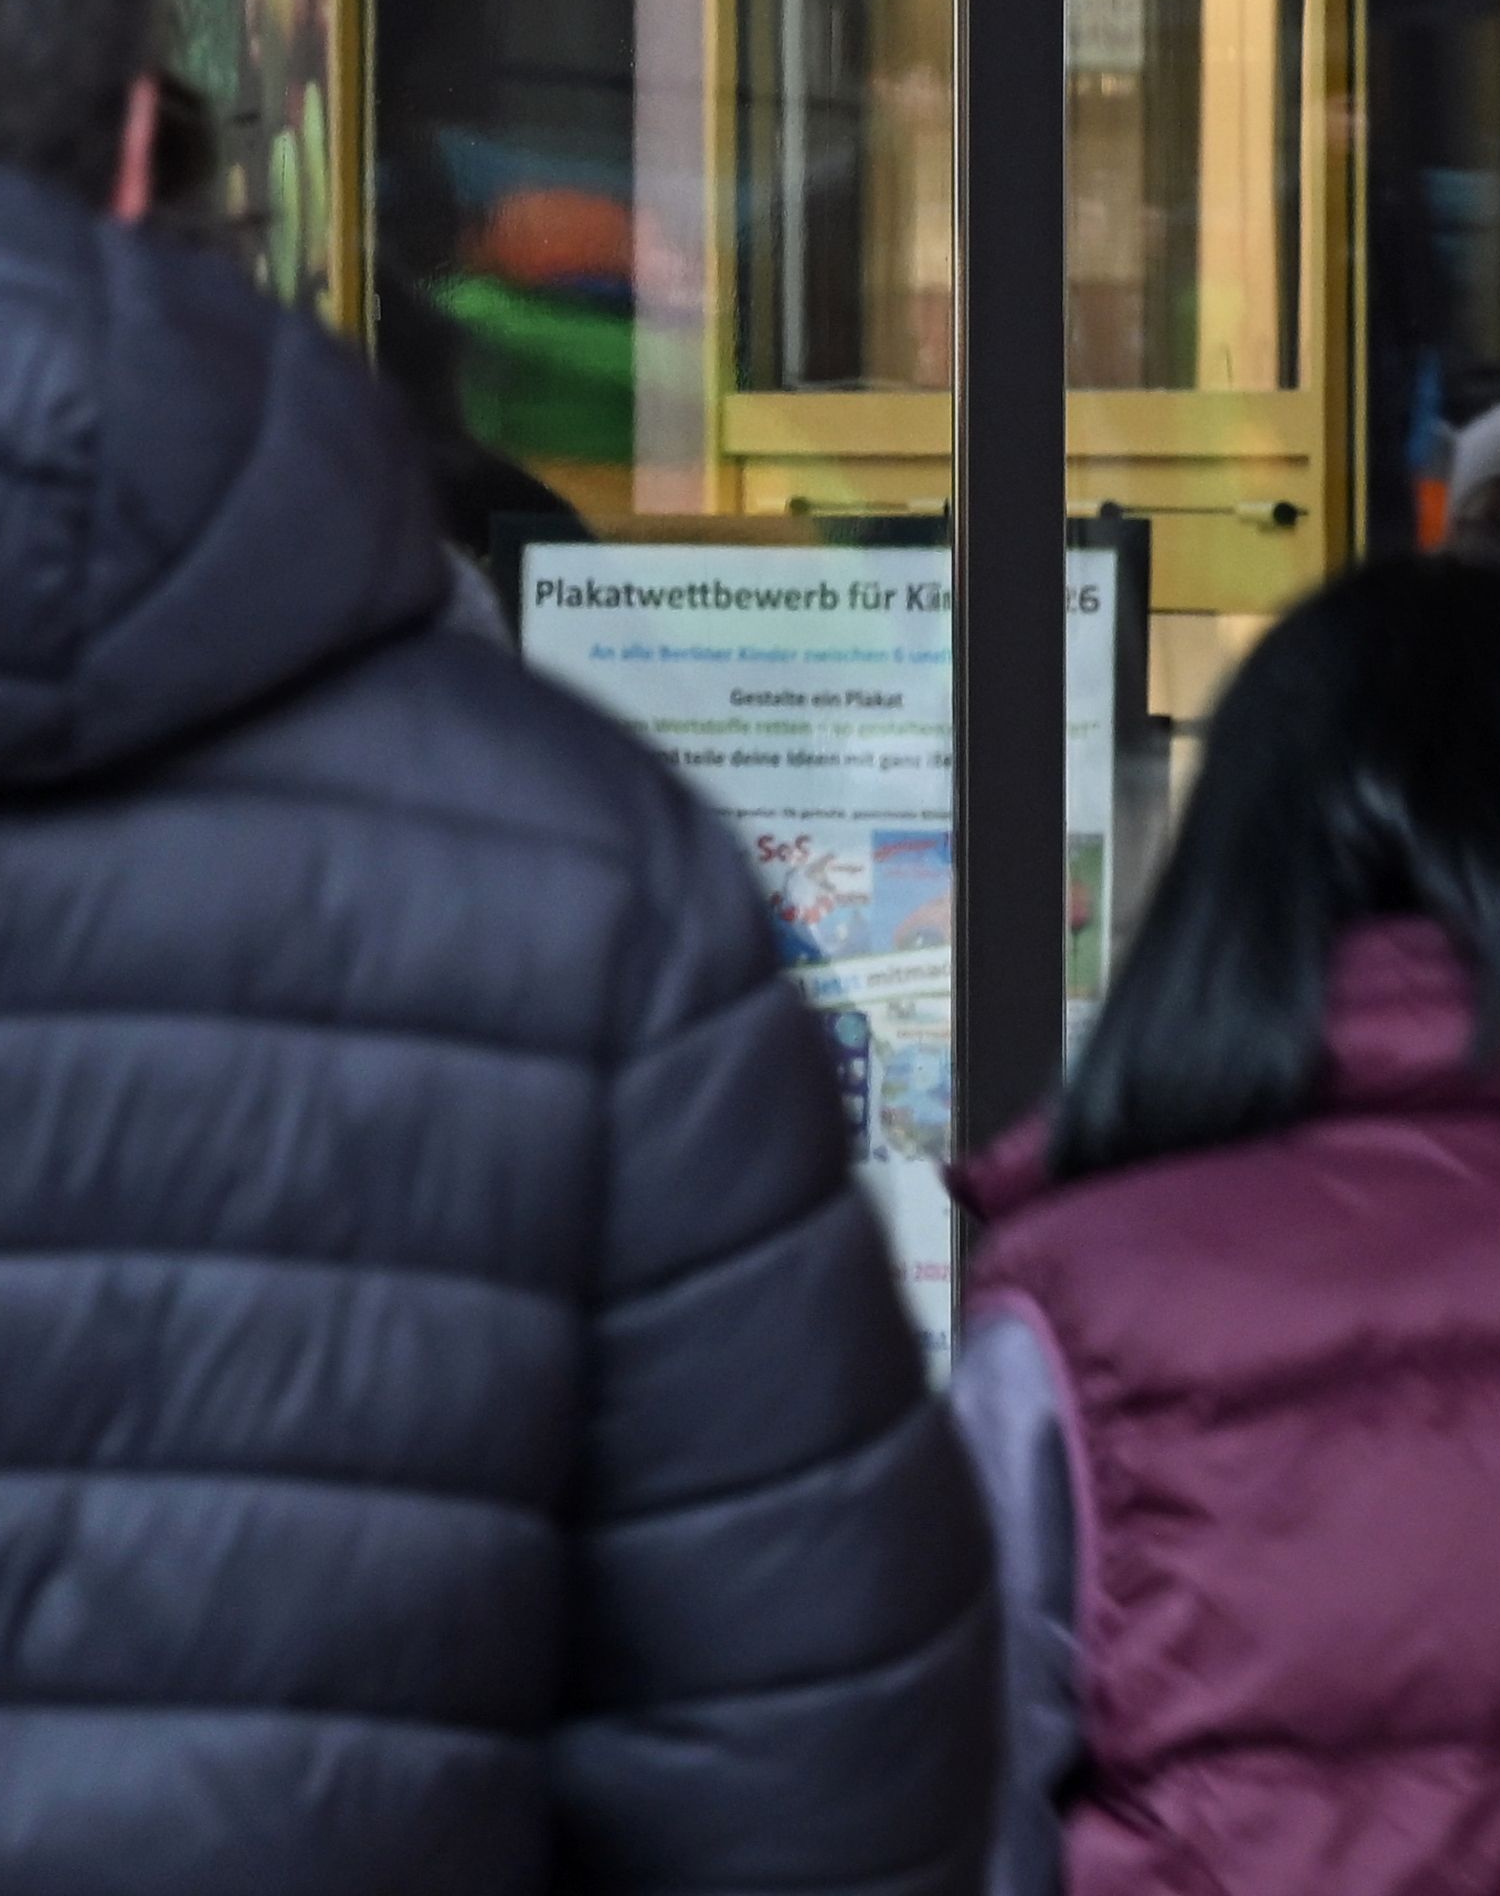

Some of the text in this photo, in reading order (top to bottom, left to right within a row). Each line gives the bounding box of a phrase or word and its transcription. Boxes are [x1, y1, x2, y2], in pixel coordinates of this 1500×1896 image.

[535, 577, 840, 612] Plakatwettbewerb
[848, 580, 898, 612] für
[730, 687, 904, 709] Gestalte ein Plakat
